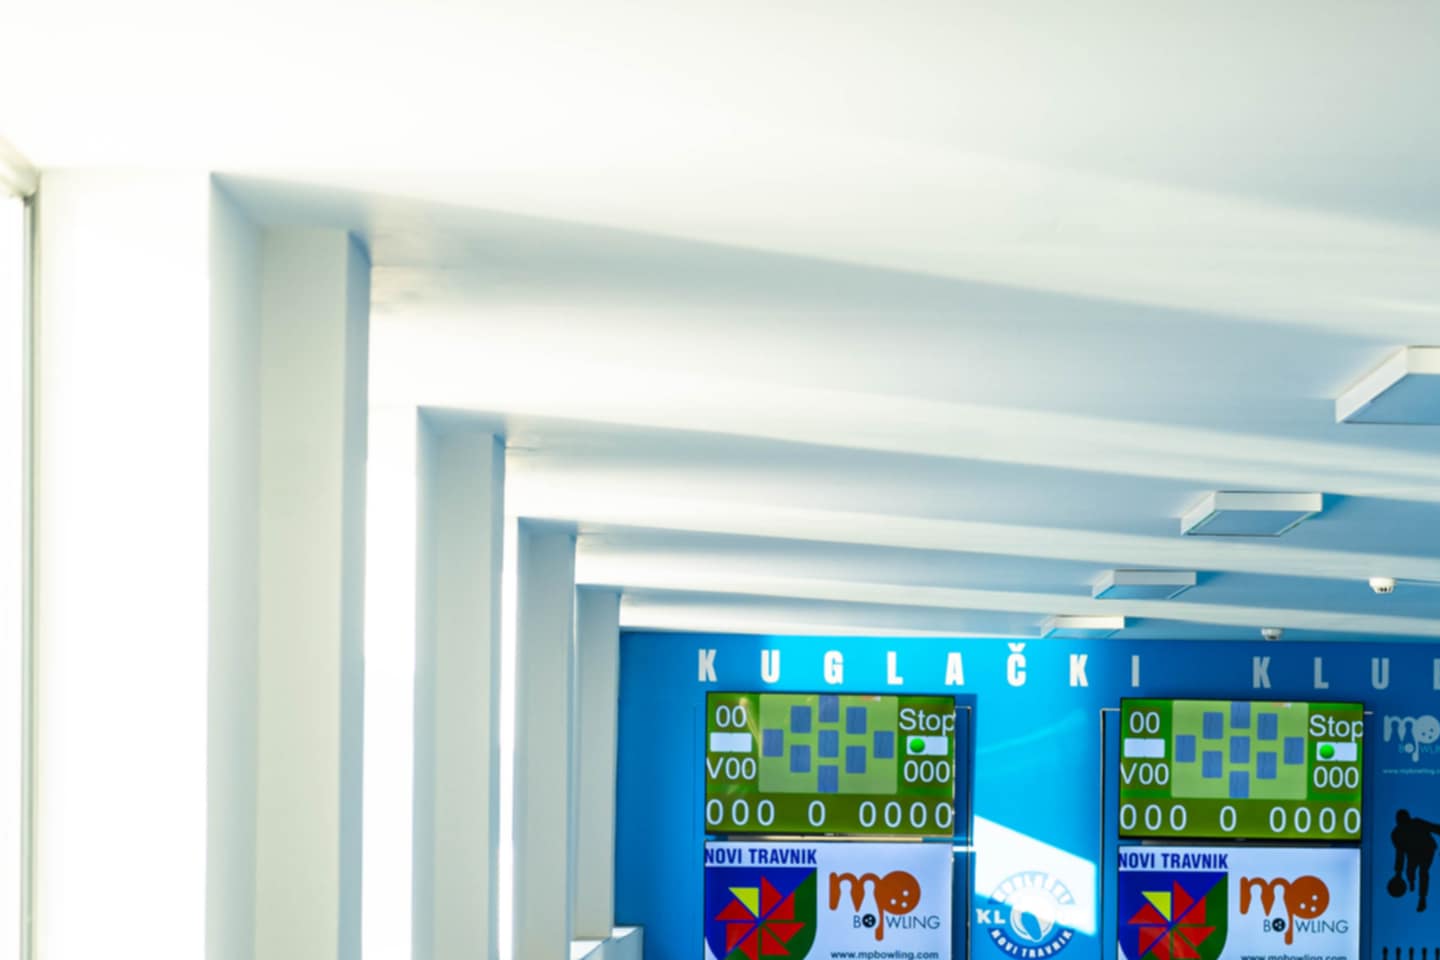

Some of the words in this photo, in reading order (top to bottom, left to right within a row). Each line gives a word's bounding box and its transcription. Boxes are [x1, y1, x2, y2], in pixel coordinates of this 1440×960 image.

[698, 643, 1140, 688] KUGLAČKI
[715, 705, 747, 728] 00
[899, 708, 955, 736] Stop
[1129, 712, 1160, 734] 00
[1309, 714, 1363, 741] Stop
[707, 757, 757, 780] V00
[904, 761, 951, 783] 000
[1121, 763, 1169, 785] V00
[1313, 766, 1359, 789] 000
[705, 848, 742, 864] NOVI
[749, 849, 817, 865] TRAVNIK
[1119, 853, 1155, 869] NOVI
[1162, 853, 1228, 869] TRAVNIK
[853, 914, 940, 929] BOWLING
[1263, 918, 1349, 933] BOWLING
[831, 950, 939, 960] www.mpbowling.com
